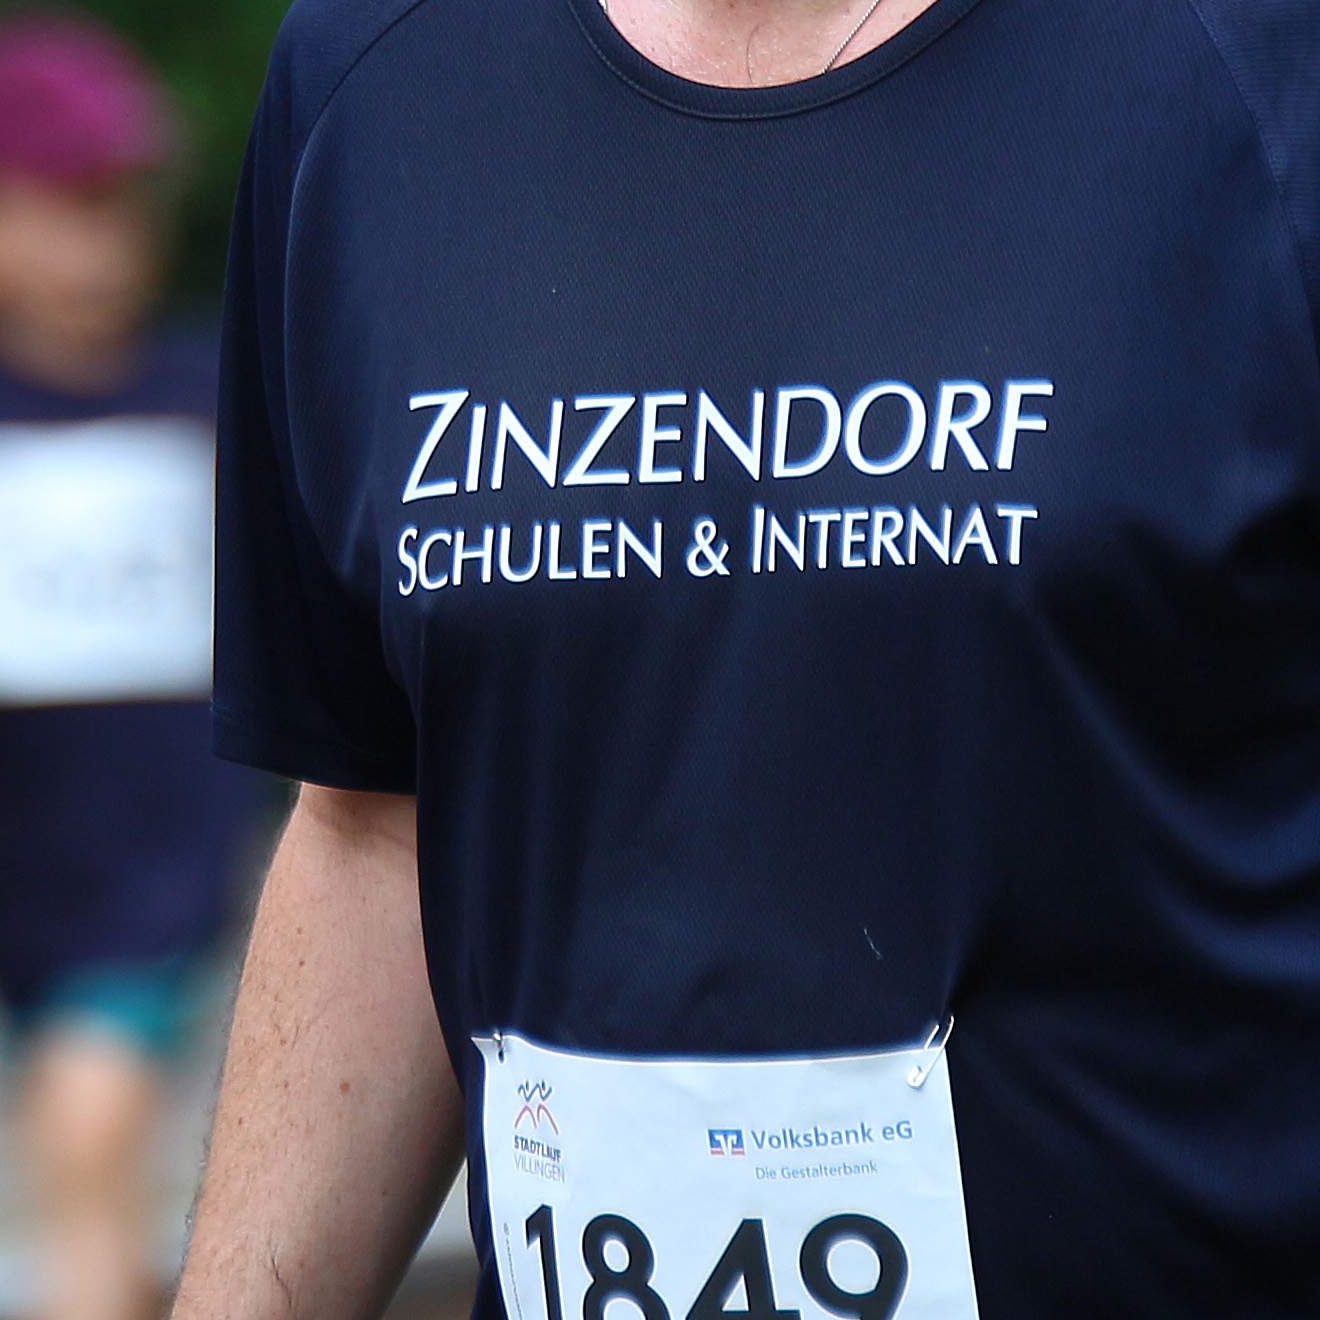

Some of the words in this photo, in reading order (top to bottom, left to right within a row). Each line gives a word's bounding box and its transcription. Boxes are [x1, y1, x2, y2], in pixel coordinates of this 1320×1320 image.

[402, 381, 1053, 504] ZINZENDORF
[397, 519, 663, 596] SCHULEN
[685, 519, 730, 577] &
[752, 505, 1039, 574] INTERNAT
[751, 1122, 874, 1150] Volksbank
[882, 1120, 914, 1141] eG
[514, 1153, 566, 1183] VILLINGEN
[755, 1166, 778, 1180] Die
[781, 1160, 879, 1180] Gestalterbank
[525, 1202, 910, 1320] 1849
